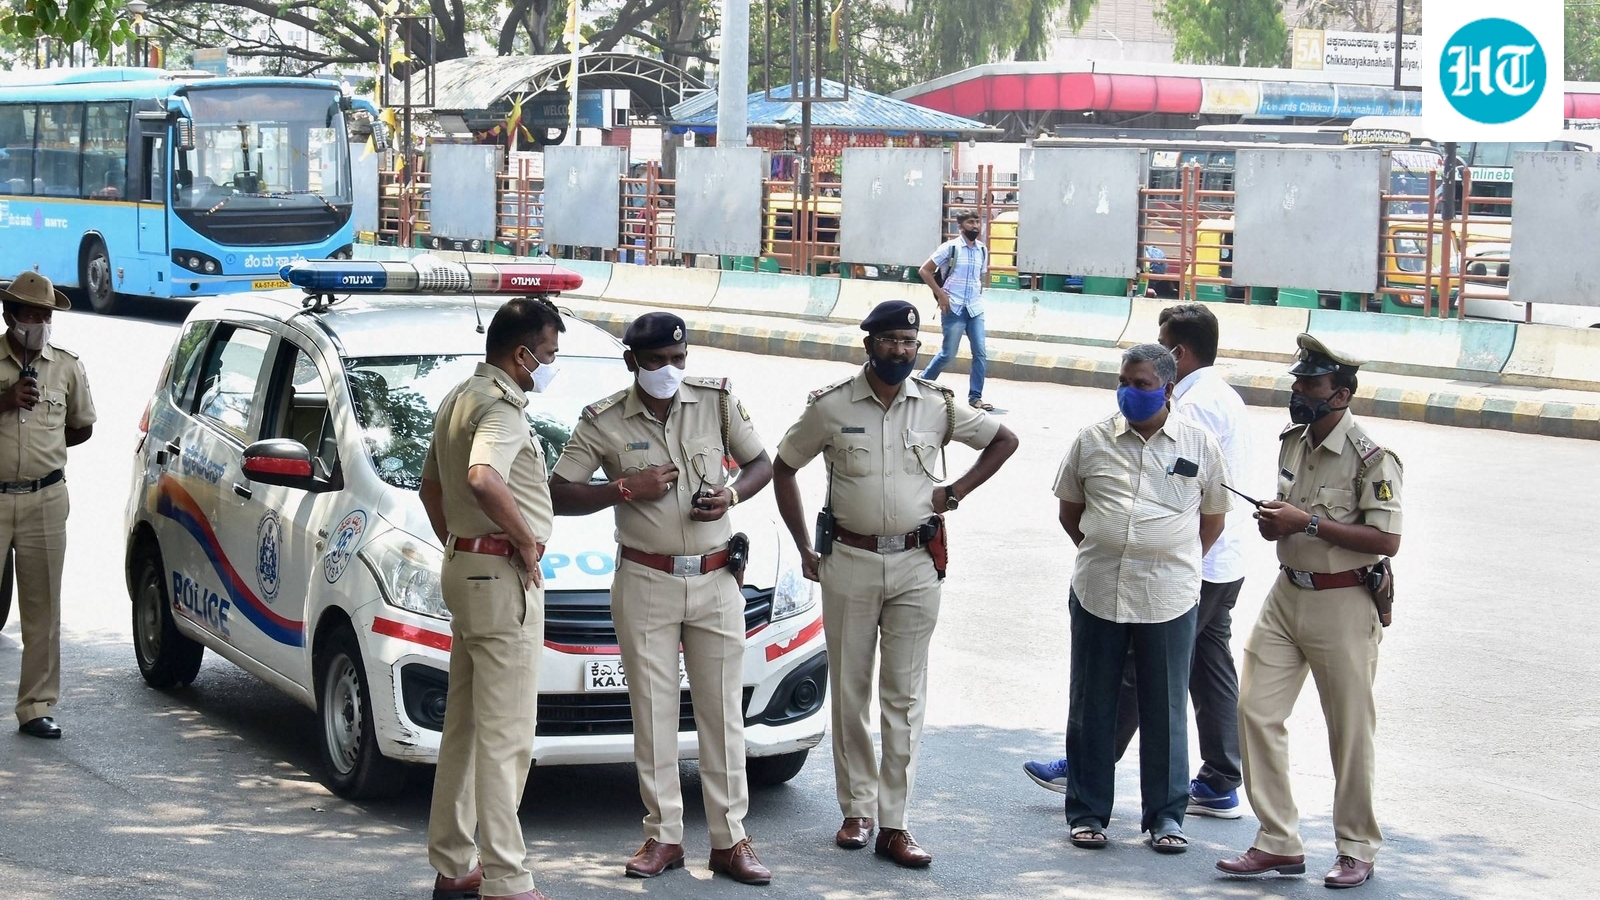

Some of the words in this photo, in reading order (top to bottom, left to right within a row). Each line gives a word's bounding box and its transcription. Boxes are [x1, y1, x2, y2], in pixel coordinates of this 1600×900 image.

[1296, 39, 1321, 62] 5A
[1326, 54, 1394, 70] Chikkanayakanahalli,
[1398, 57, 1420, 72] uliyar,
[44, 217, 68, 228] BMTC
[540, 552, 615, 579] PO
[173, 571, 230, 636] POLICE
